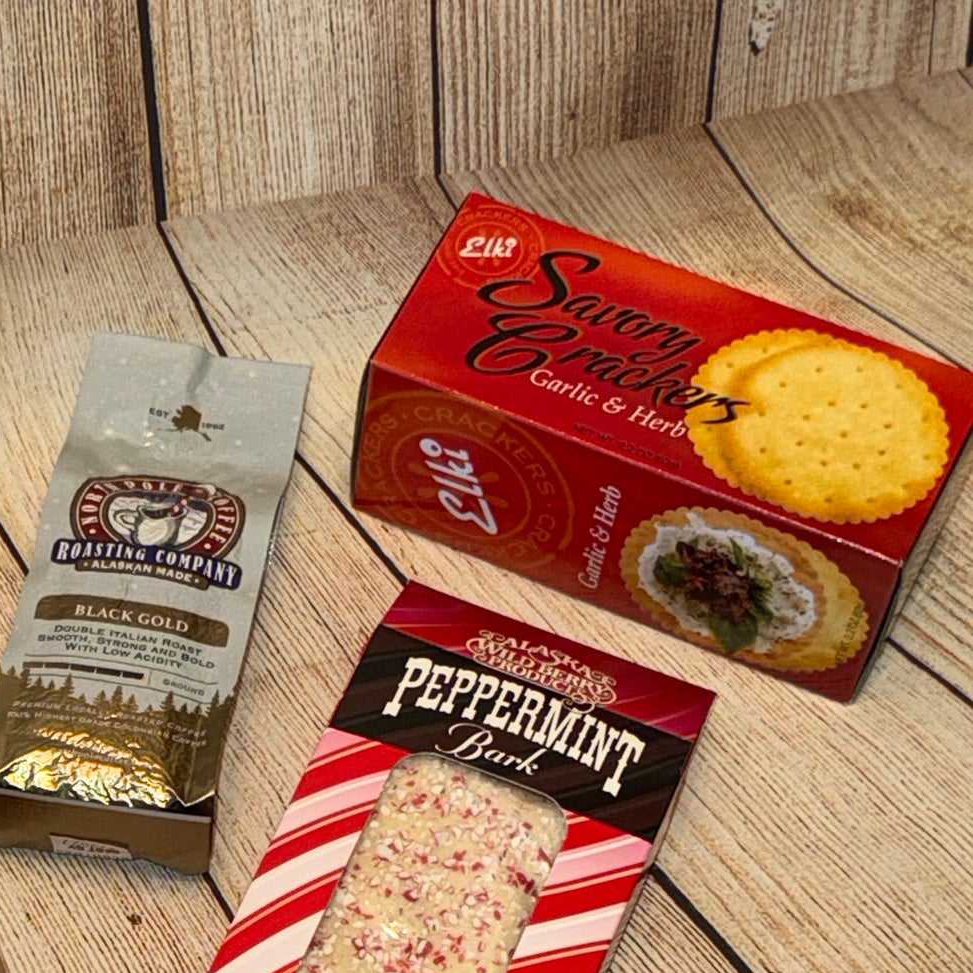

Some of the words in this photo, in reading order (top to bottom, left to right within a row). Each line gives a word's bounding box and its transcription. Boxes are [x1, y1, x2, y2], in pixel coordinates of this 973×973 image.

[459, 237, 518, 258] Elki
[477, 249, 701, 363] Savory
[465, 311, 751, 424] Crackers
[529, 368, 599, 406] Garlic
[602, 396, 627, 414] &
[628, 405, 688, 438] Herb
[419, 437, 498, 535] Elki
[593, 485, 622, 527] Herb
[589, 525, 611, 543] &
[56, 540, 147, 562] ROASTING
[156, 548, 237, 588] COMPANY
[91, 560, 152, 574] ALASKAN
[156, 565, 192, 583] MADE
[578, 542, 607, 590] Garlic
[54, 625, 104, 637] DOUBLE
[109, 628, 157, 645] ITALIAN
[162, 638, 202, 656] ROAST
[74, 604, 133, 623] BLACK
[137, 610, 189, 633] GOLD
[65, 642, 100, 653] WITH
[103, 645, 131, 658] LOW
[134, 651, 183, 669] ACIDITY
[96, 636, 148, 653] STRONG
[152, 646, 178, 660] AND
[181, 652, 215, 670] BOLD
[477, 638, 536, 668] WILD
[538, 662, 610, 699] BERRY
[382, 656, 646, 797] PEPPERMINT
[434, 722, 547, 776] Bark
